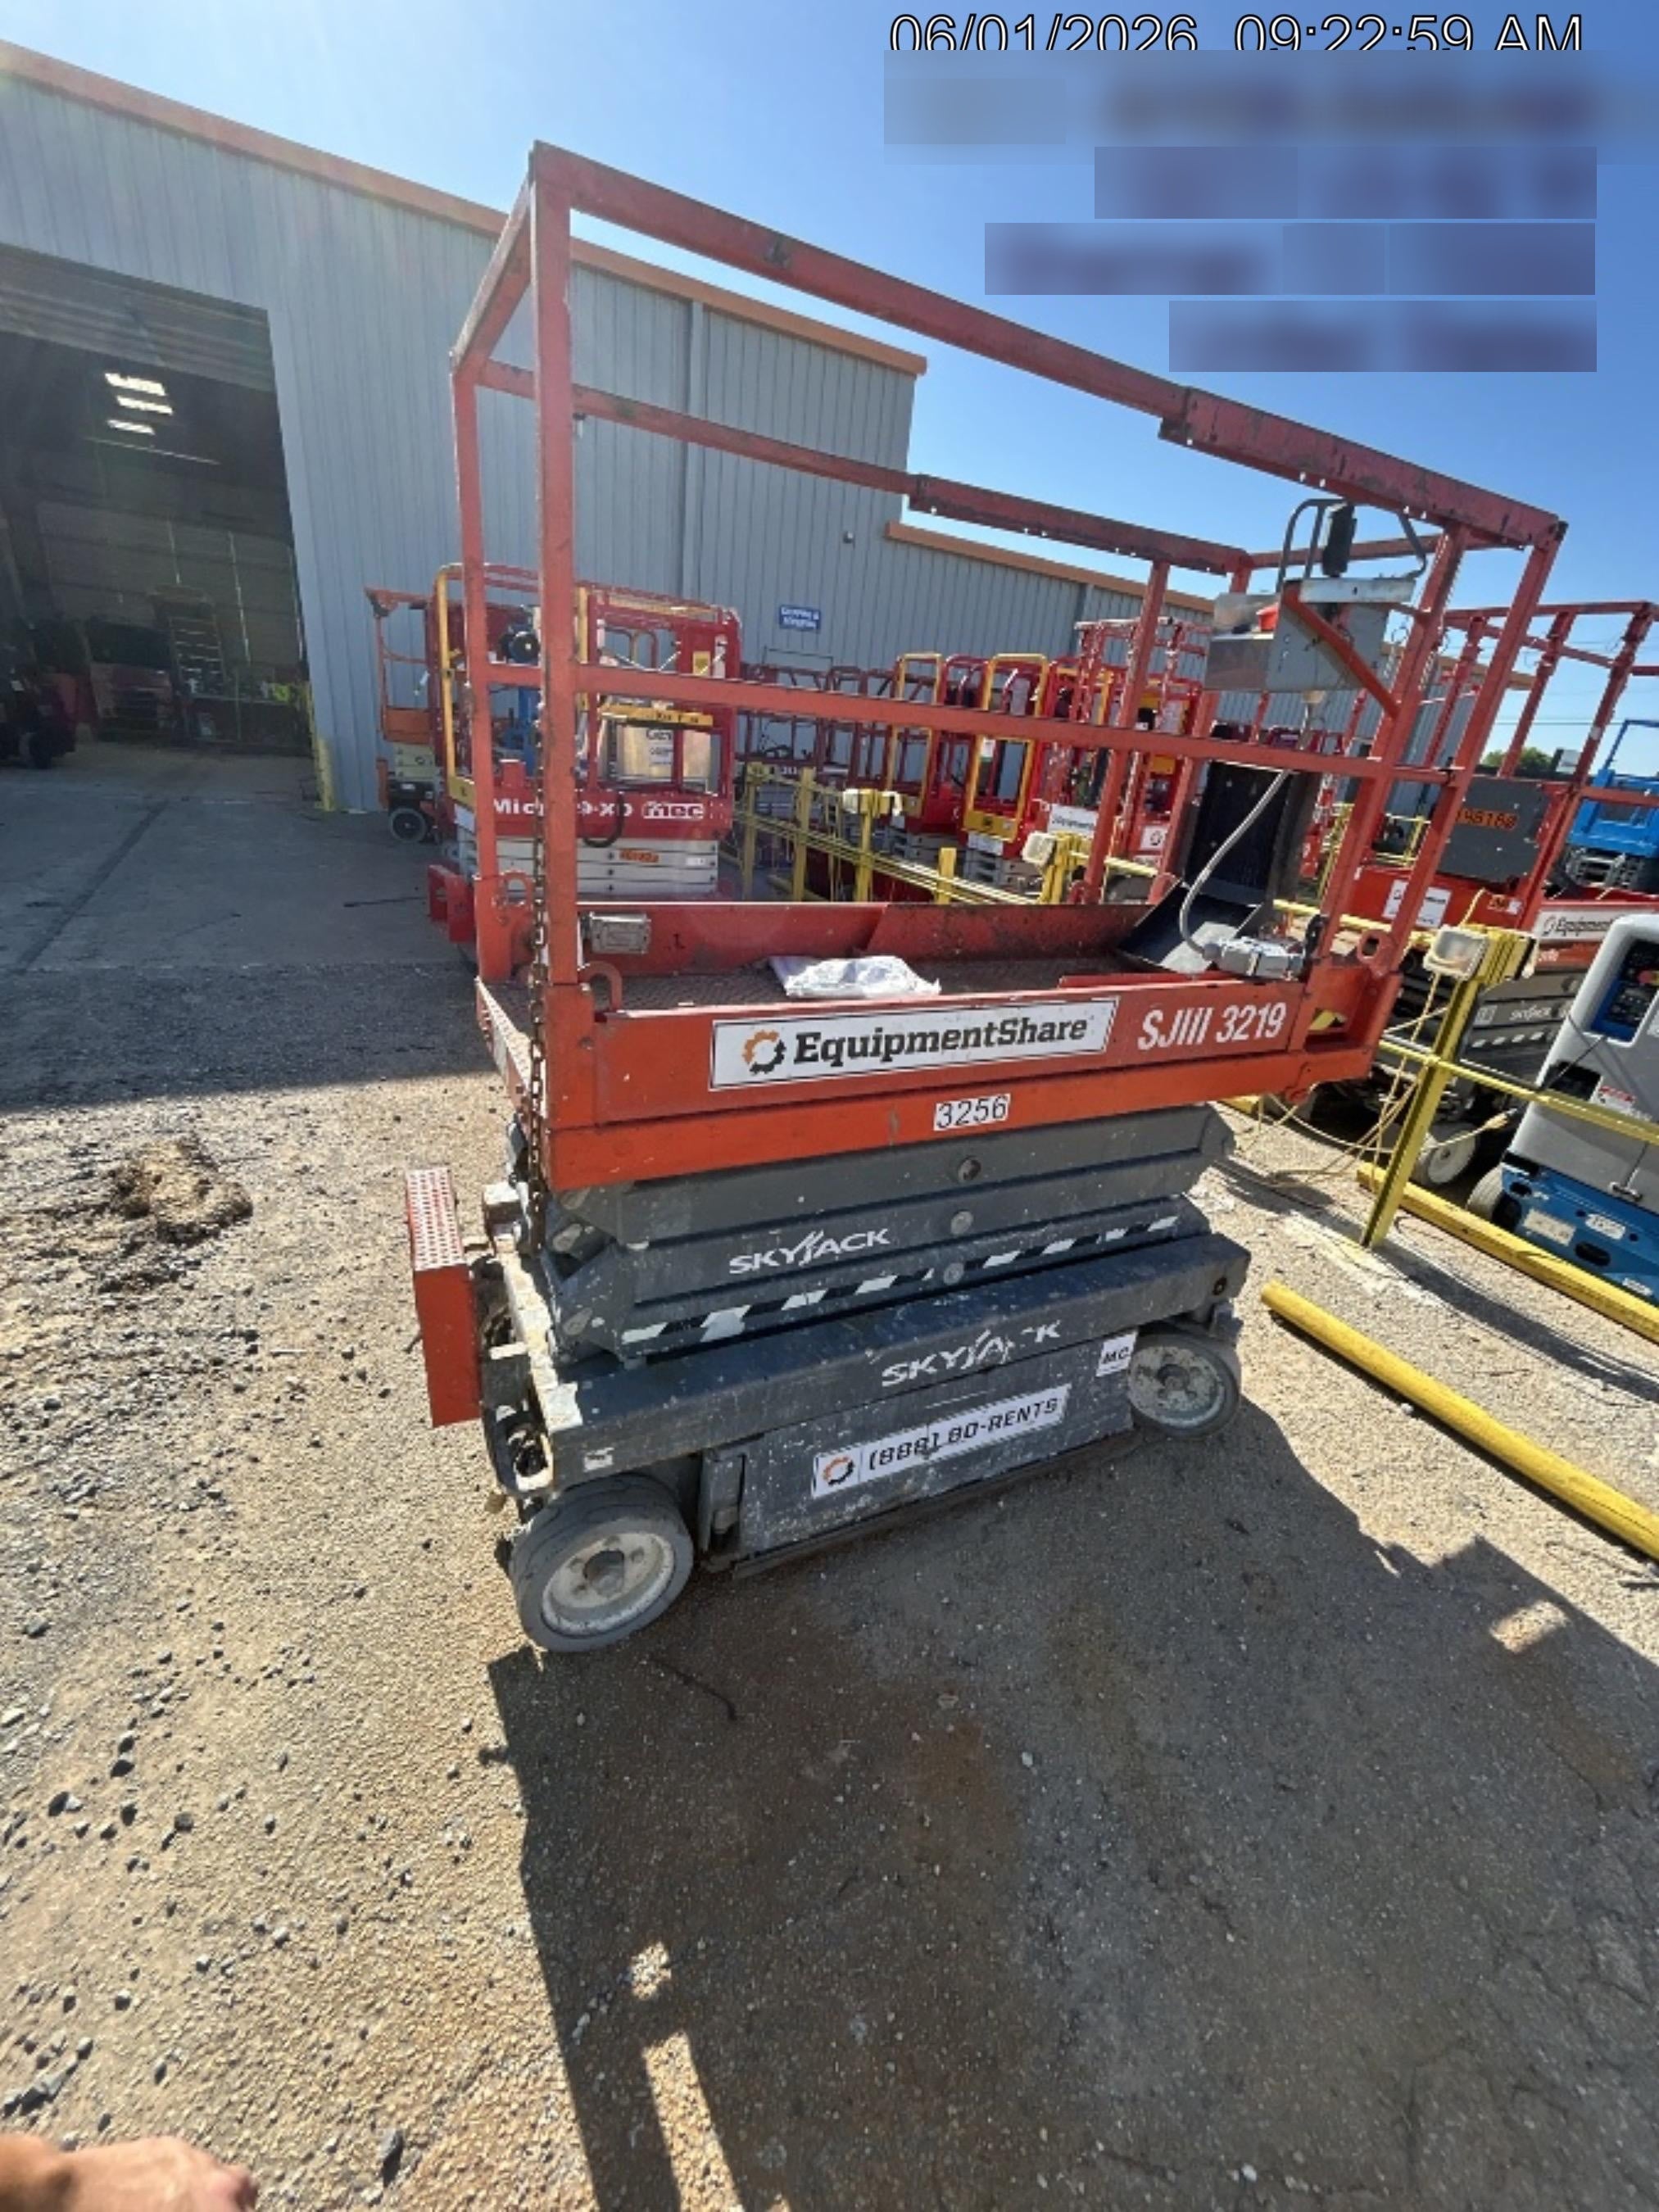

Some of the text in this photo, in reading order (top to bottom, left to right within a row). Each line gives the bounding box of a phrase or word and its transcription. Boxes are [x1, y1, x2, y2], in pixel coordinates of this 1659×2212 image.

[793, 1014, 1088, 1067] EquipmentShare
[1137, 1001, 1286, 1050] SJIII 3219
[935, 1095, 1009, 1130] 3256
[729, 1229, 891, 1274] SKYJACK
